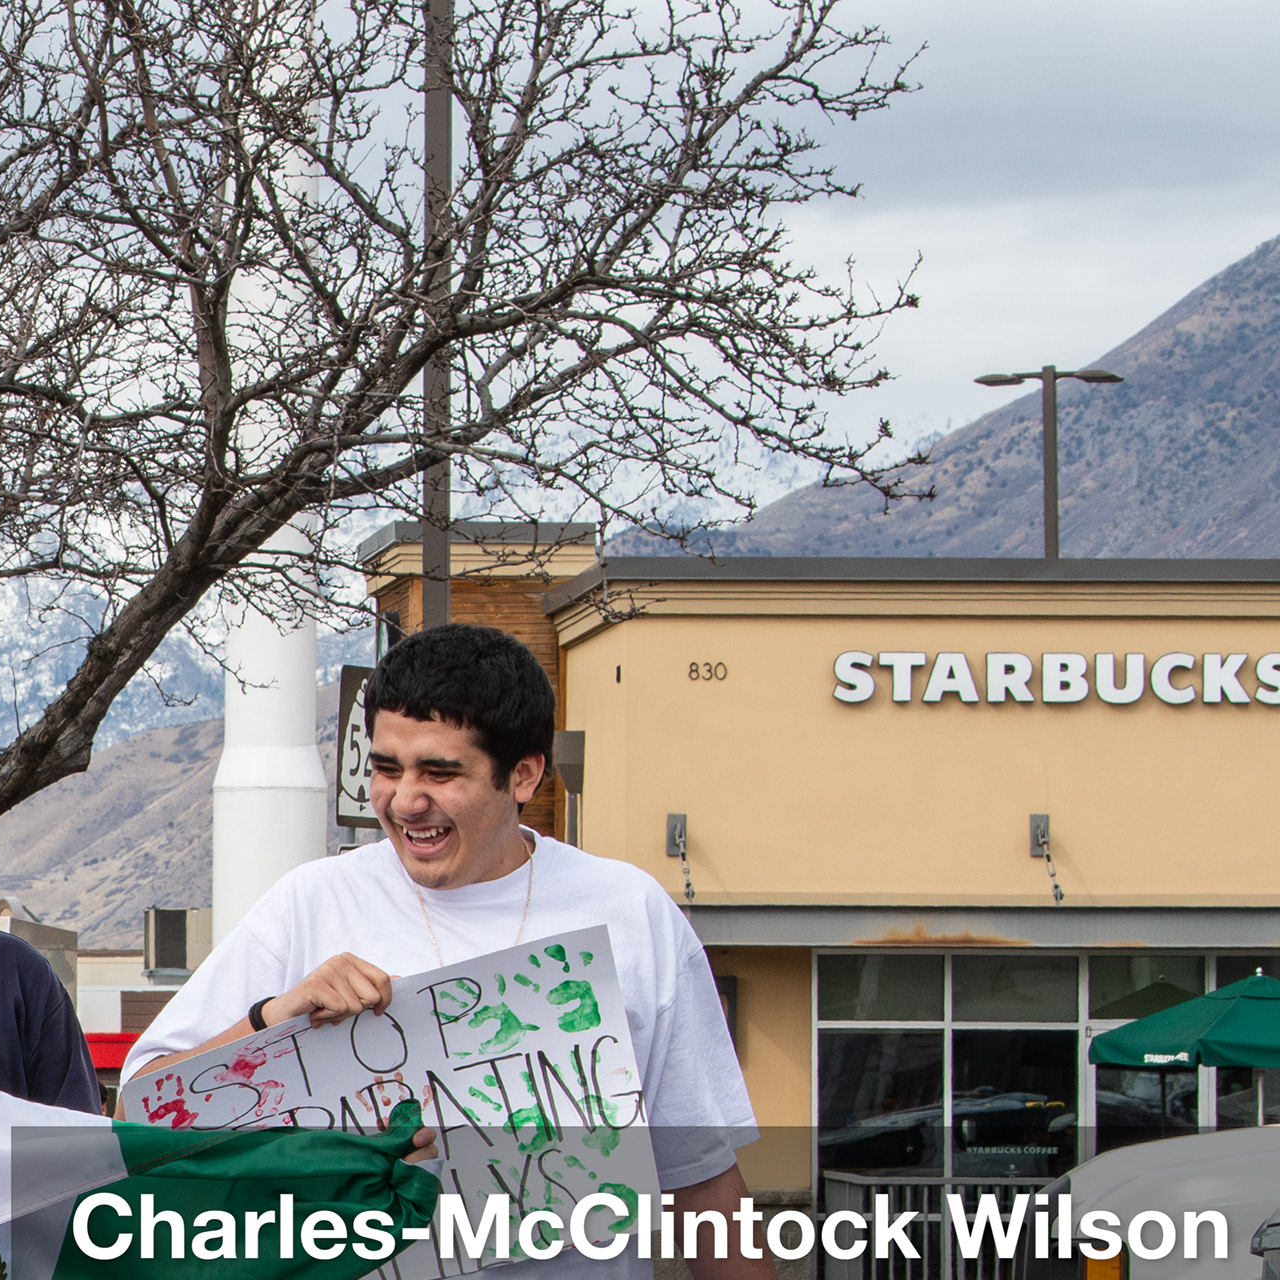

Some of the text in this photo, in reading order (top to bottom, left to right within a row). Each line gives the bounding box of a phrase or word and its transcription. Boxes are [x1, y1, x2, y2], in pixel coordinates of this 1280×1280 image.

[688, 661, 728, 681] 830
[833, 650, 1280, 704] STARBUCKS
[189, 975, 482, 1132] STOP
